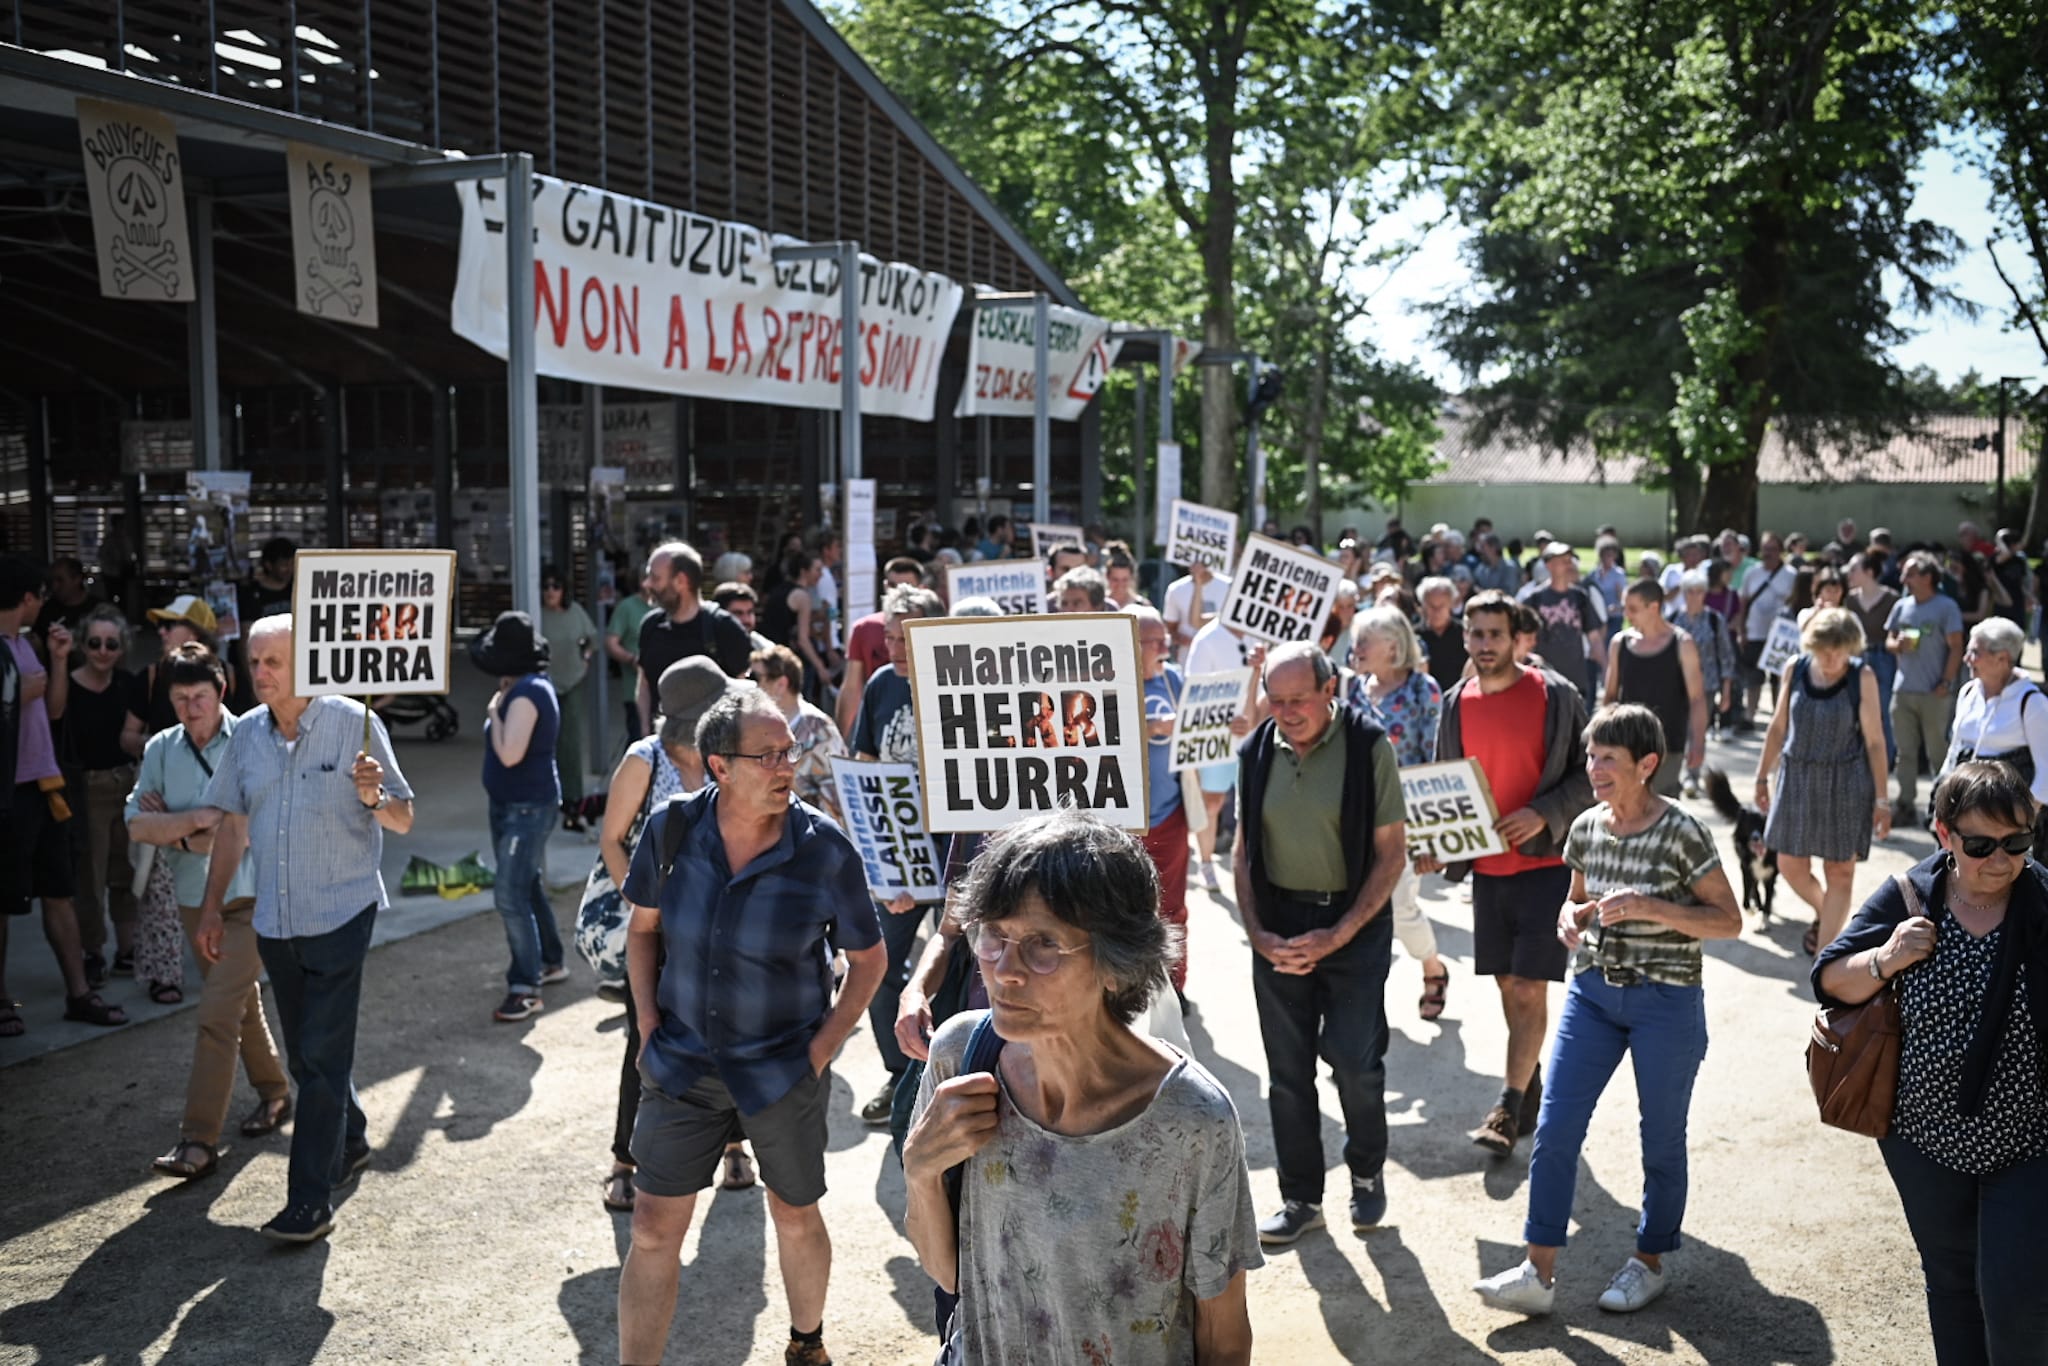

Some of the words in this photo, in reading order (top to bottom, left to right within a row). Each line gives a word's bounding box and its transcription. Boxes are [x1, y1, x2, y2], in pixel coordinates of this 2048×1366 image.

[84, 121, 177, 184] BOUYGUES
[306, 160, 352, 196] A69
[533, 259, 640, 356] NON
[664, 294, 690, 372] A
[705, 298, 753, 376] LA
[1176, 523, 1228, 551] LAISSE
[311, 569, 435, 599] Marienia
[957, 571, 1036, 595] Marienia
[1250, 549, 1330, 593] Marienia
[1240, 571, 1324, 621] HERRI
[309, 601, 434, 643] HERRI
[1230, 598, 1313, 642] LURRA
[309, 645, 434, 685] LURRA
[933, 640, 1116, 686] Marienia
[938, 689, 1121, 749] HERRI
[1180, 703, 1235, 734] LAISSE
[1176, 733, 1232, 765] BETON
[944, 755, 1129, 811] LURRA
[842, 774, 884, 887] Marienia
[858, 775, 909, 888] LAISSE
[886, 776, 938, 887] BETON
